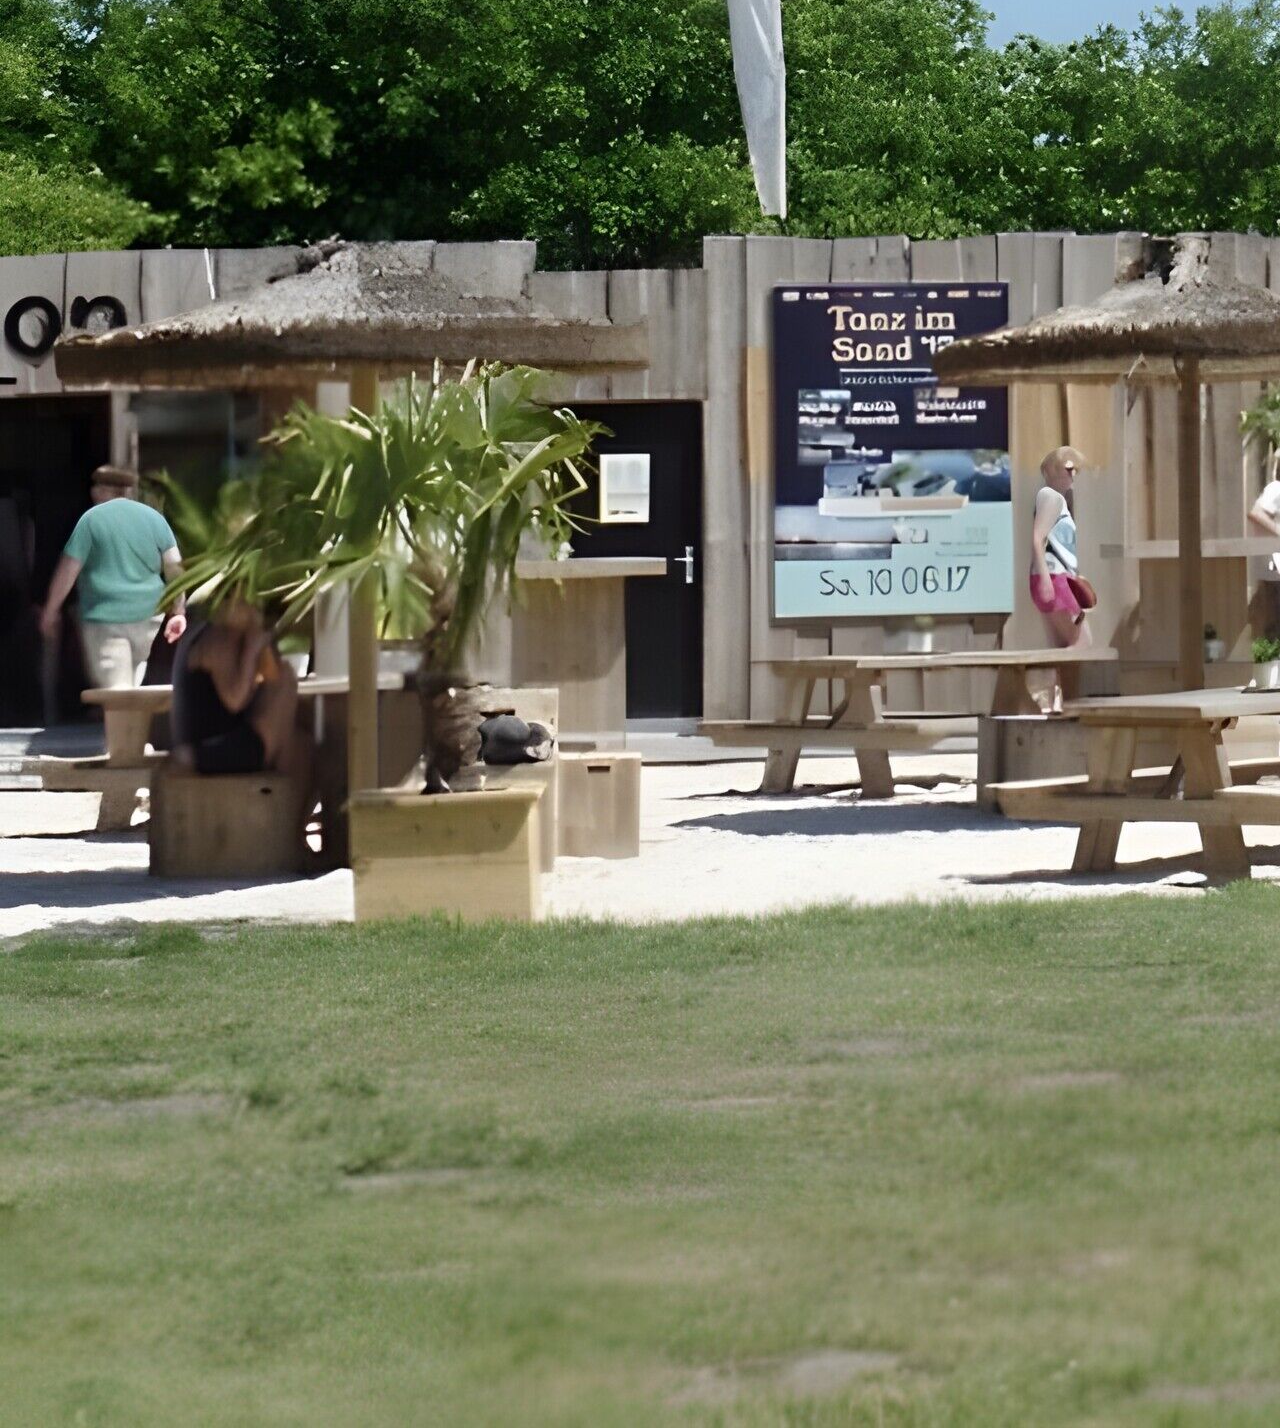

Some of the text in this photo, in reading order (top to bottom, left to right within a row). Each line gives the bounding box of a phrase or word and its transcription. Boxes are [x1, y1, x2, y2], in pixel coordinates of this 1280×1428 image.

[827, 305, 956, 331] Tanz im
[831, 335, 912, 362] Sand
